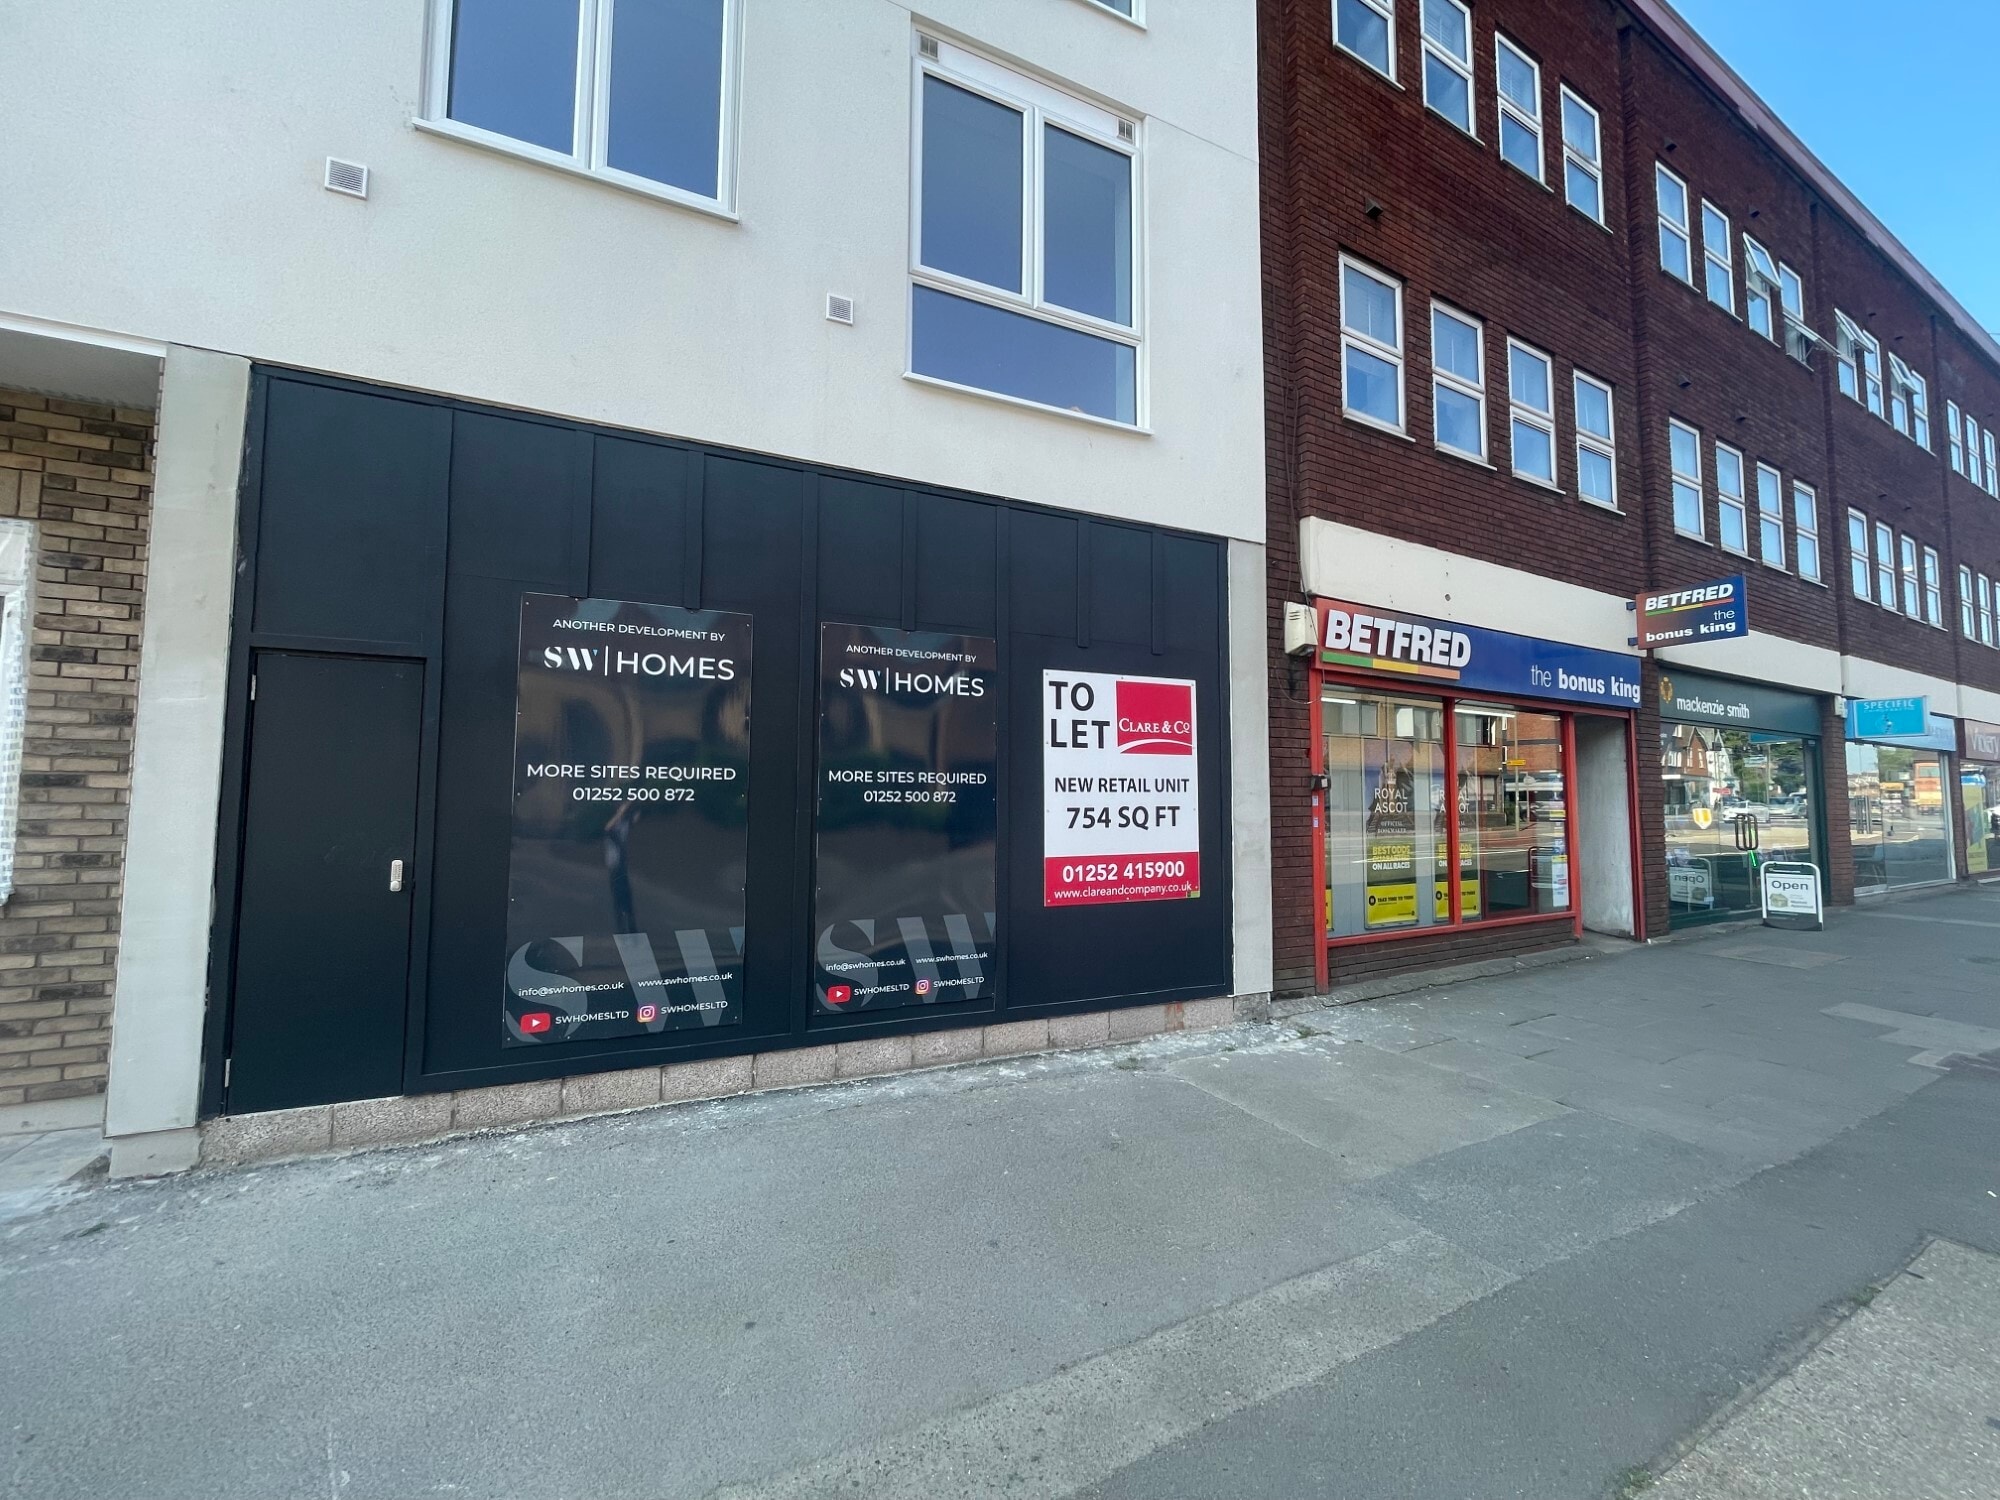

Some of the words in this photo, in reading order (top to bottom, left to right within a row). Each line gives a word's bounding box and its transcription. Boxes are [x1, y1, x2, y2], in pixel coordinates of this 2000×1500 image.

[1645, 583, 1734, 612] BETFRED
[1713, 608, 1736, 621] the
[552, 618, 616, 633] ANOTHER
[618, 624, 708, 641] DEVELOPMENT
[709, 632, 726, 643] BY
[1325, 609, 1472, 669] BETFRED
[1645, 626, 1694, 642] bonus
[1699, 620, 1736, 636] king
[543, 646, 599, 672] SW
[616, 651, 736, 681] HOMES
[845, 644, 894, 657] ANOTHER
[895, 648, 963, 663] DEVELOPMENT
[964, 654, 977, 664] BY
[839, 667, 881, 691] SW
[894, 671, 986, 697] HOMES
[1531, 664, 1552, 688] the
[1557, 668, 1606, 696] bonus
[1610, 676, 1641, 705] king
[1048, 680, 1095, 712] TO
[1863, 699, 1915, 710] SPECIFIC
[1676, 696, 1725, 717] mackenzie
[1726, 704, 1750, 719] smith
[1050, 718, 1111, 750] LET
[1161, 719, 1173, 735] &
[526, 763, 586, 779] MORE
[590, 765, 641, 780] SITES
[645, 766, 737, 782] REQUIRED
[828, 769, 874, 783] MORE
[876, 771, 915, 784] SITES
[918, 772, 987, 786] REQUIRED
[572, 787, 623, 802] 01252
[627, 788, 660, 802] 500
[664, 788, 696, 802] 872
[1053, 777, 1094, 794] NEW
[1098, 777, 1151, 793] RETAIL
[1154, 778, 1190, 793] UNIT
[1374, 788, 1408, 800] ROYAL
[863, 790, 902, 803] 01252
[904, 791, 930, 803] 500
[932, 791, 957, 803] 872
[1374, 801, 1409, 814] ASCOT
[1066, 806, 1112, 830] 754
[1117, 805, 1150, 831] SQ
[1154, 805, 1181, 828] FT
[1062, 863, 1118, 883] 01252
[1123, 860, 1185, 880] 415900
[1372, 863, 1383, 871] ON
[1383, 862, 1393, 870] ALL
[1054, 880, 1192, 899] www.clareandcompany.co.uk
[1771, 880, 1809, 891] Open
[825, 958, 906, 972] info@swhomes.co.uk
[915, 951, 988, 965] www.swhomes.co.uk
[518, 981, 625, 998] info@swhomes.co.uk
[637, 971, 733, 988] www.swhomes.co.uk
[854, 983, 910, 996] SWHOMESLTD
[933, 976, 985, 989] SWHOMESLTD
[555, 1010, 629, 1025] SWHOMESLTD
[660, 1000, 728, 1015] SWHOMESLTD
